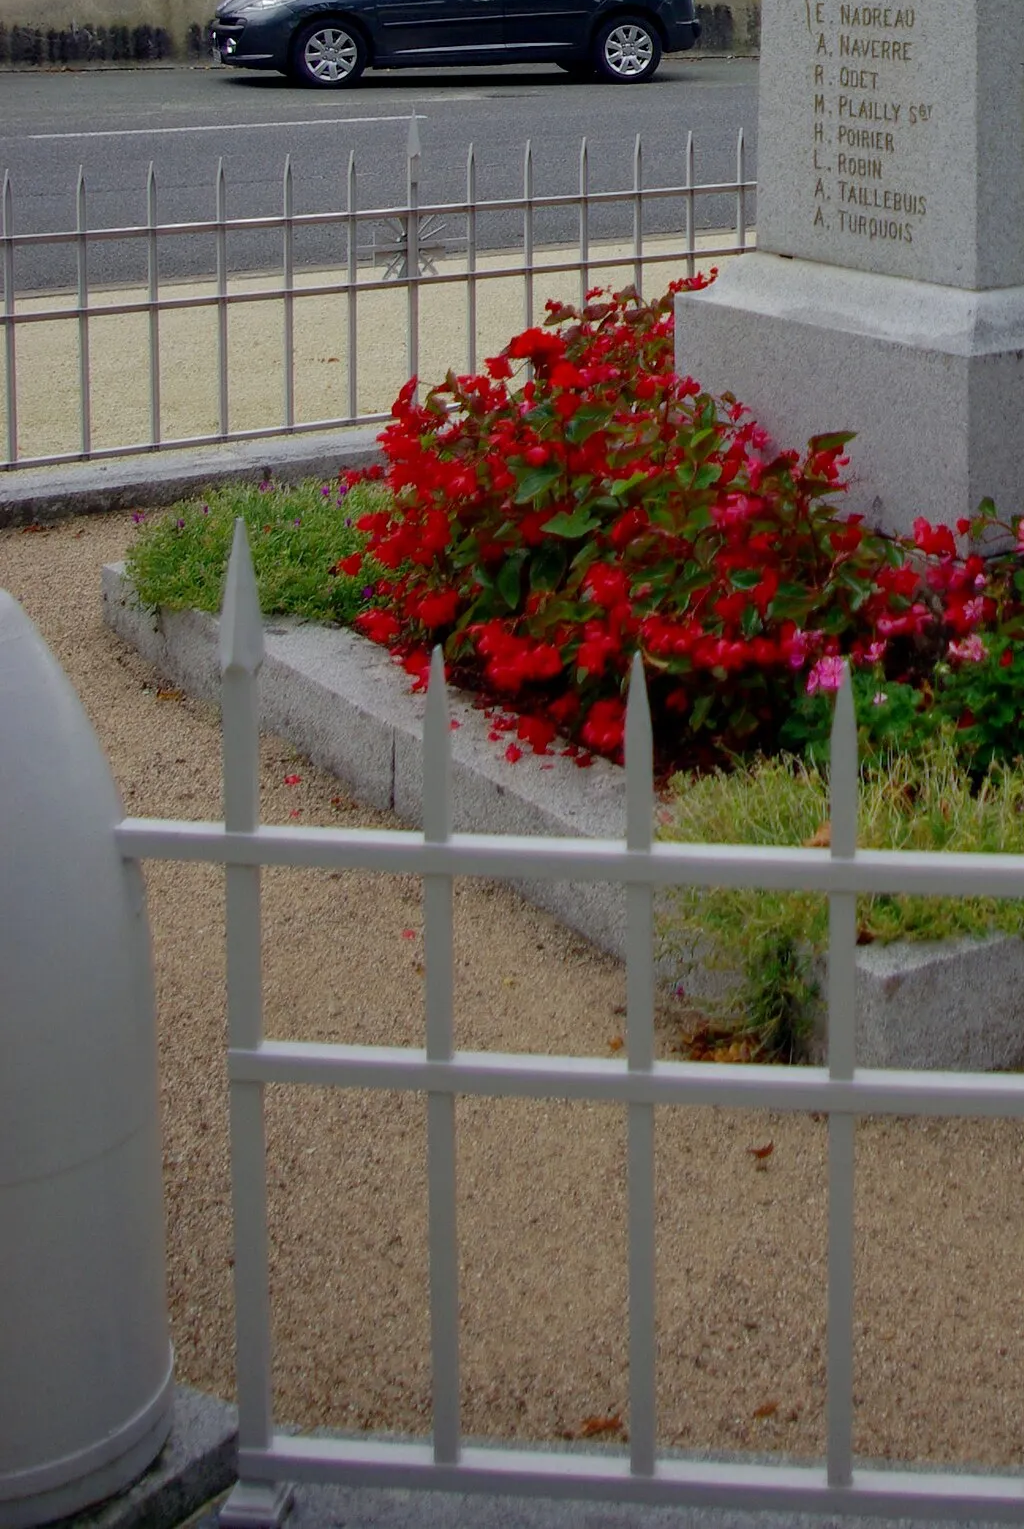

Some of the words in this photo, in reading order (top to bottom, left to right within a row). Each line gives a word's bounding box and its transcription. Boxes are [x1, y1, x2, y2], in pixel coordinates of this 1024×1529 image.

[816, 3, 834, 24] E.
[840, 4, 915, 28] NADREAU
[816, 33, 833, 57] A.
[839, 34, 912, 61] NAVERRE
[814, 64, 833, 86] R.
[839, 67, 879, 89] ODET
[814, 94, 833, 115] M.
[839, 95, 901, 123] PLAILLY
[814, 121, 832, 144] H.
[838, 125, 894, 153] POIRIER
[814, 149, 831, 172] L.
[838, 153, 882, 179] ROBIN
[814, 177, 831, 200] A.
[838, 180, 927, 216] TAILLEBUIS
[813, 206, 830, 230] A.
[838, 209, 913, 243] TURQUOIS
